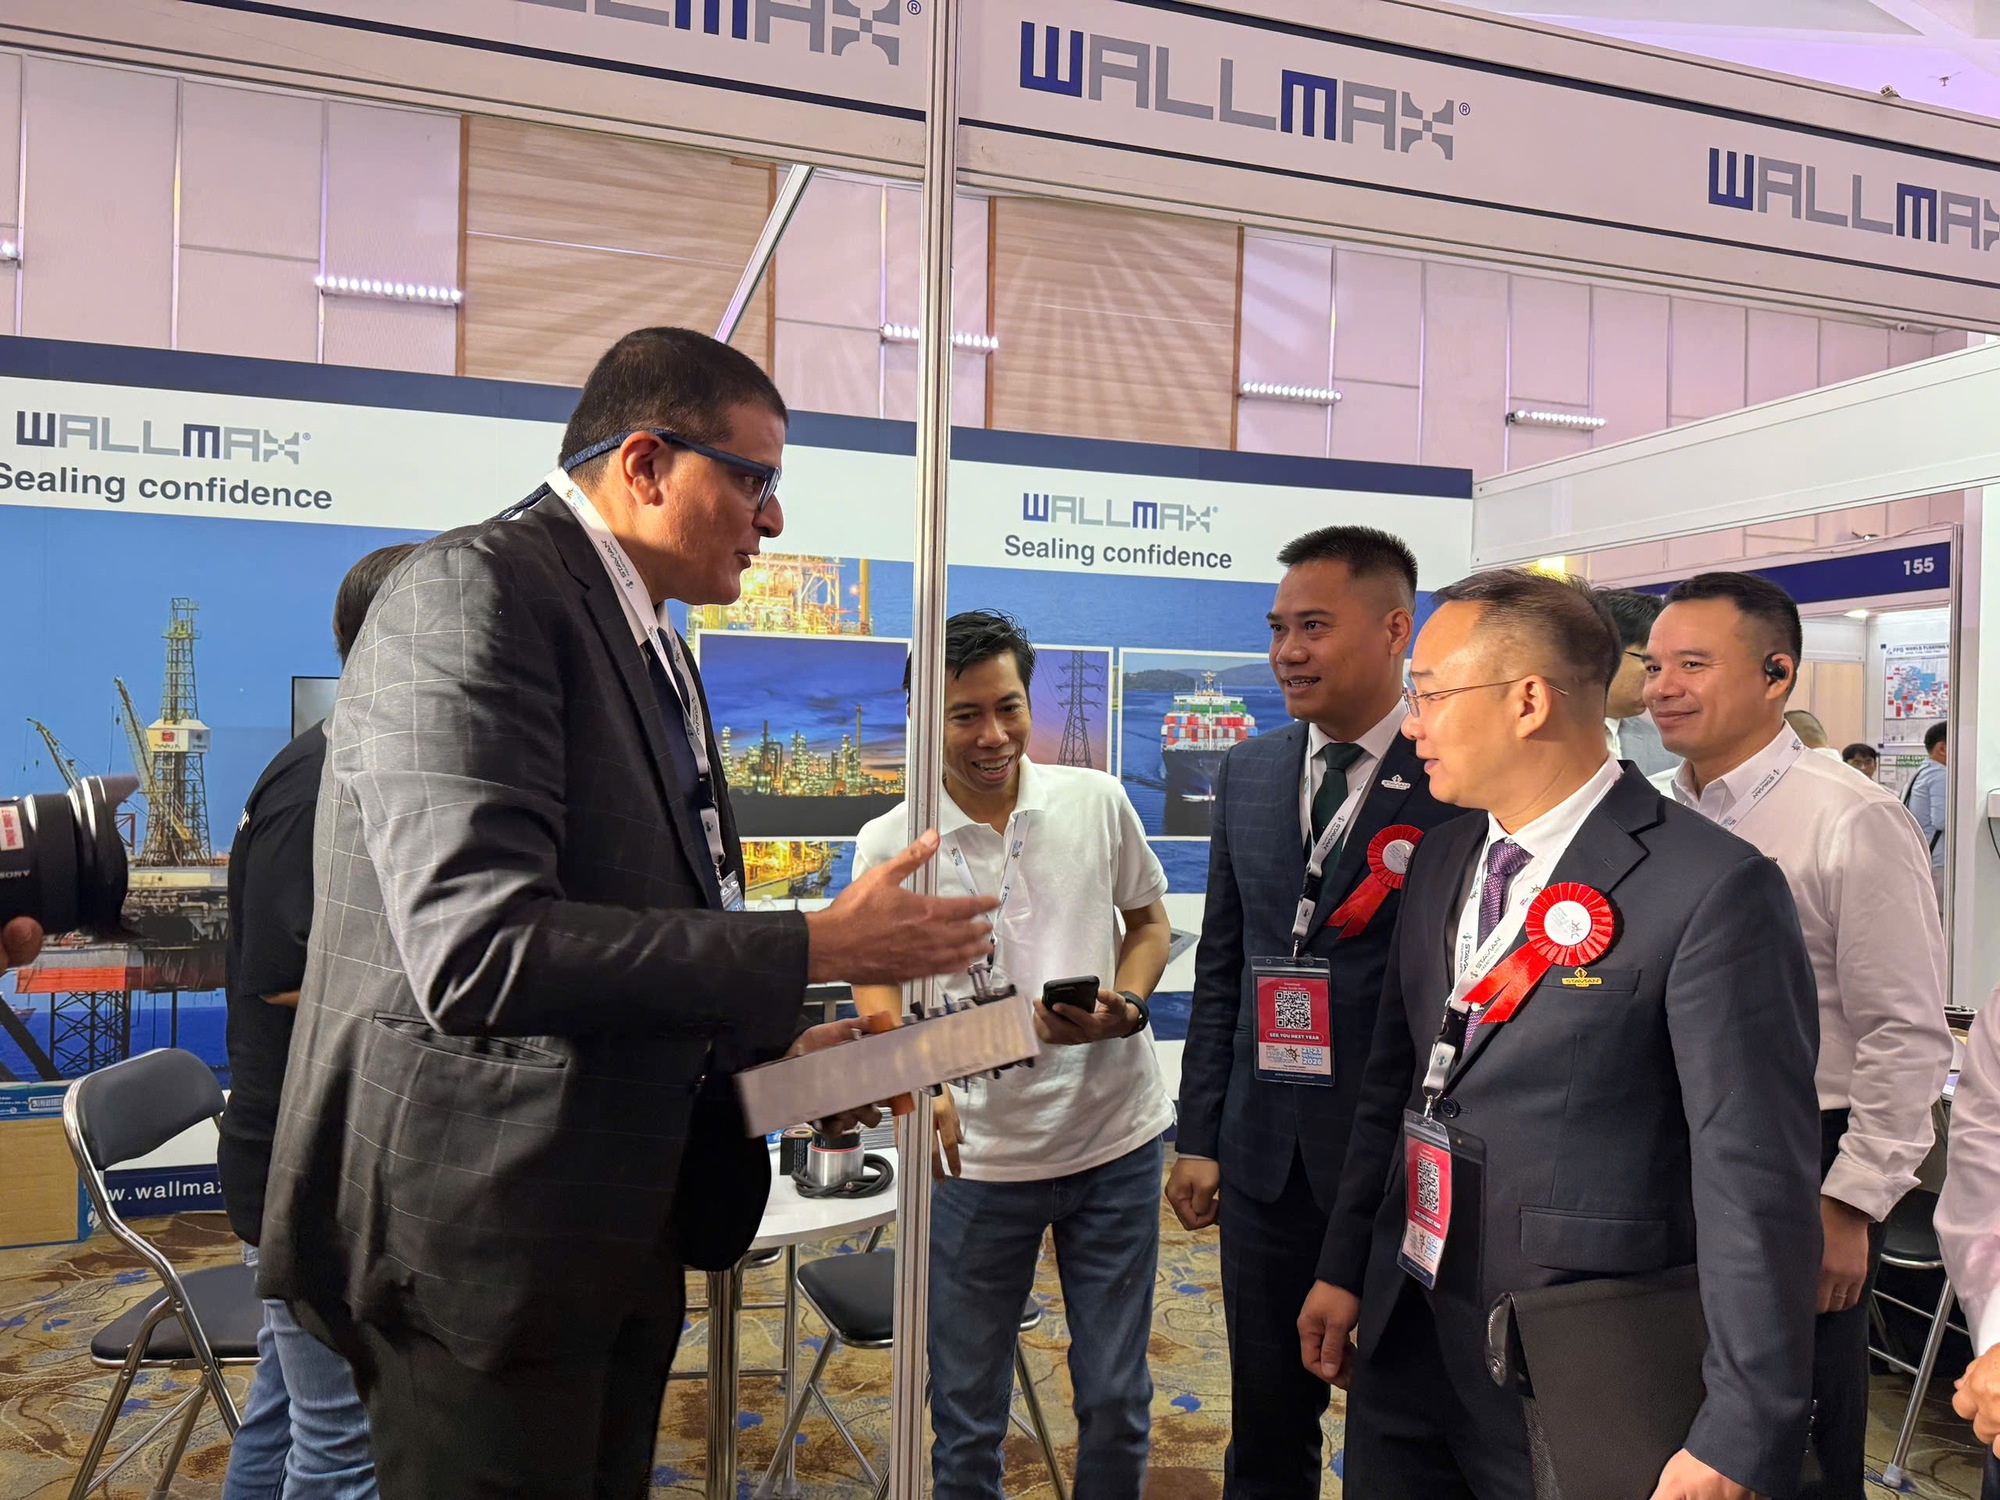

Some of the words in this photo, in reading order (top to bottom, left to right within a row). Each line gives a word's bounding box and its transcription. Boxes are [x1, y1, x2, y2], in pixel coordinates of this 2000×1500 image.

[0, 462, 126, 502] Sealing
[138, 477, 332, 509] confidence
[1004, 534, 1095, 566] Sealing
[1103, 543, 1232, 569] confidence
[1902, 557, 1935, 575] 155
[1475, 936, 1501, 969] STAVIAN
